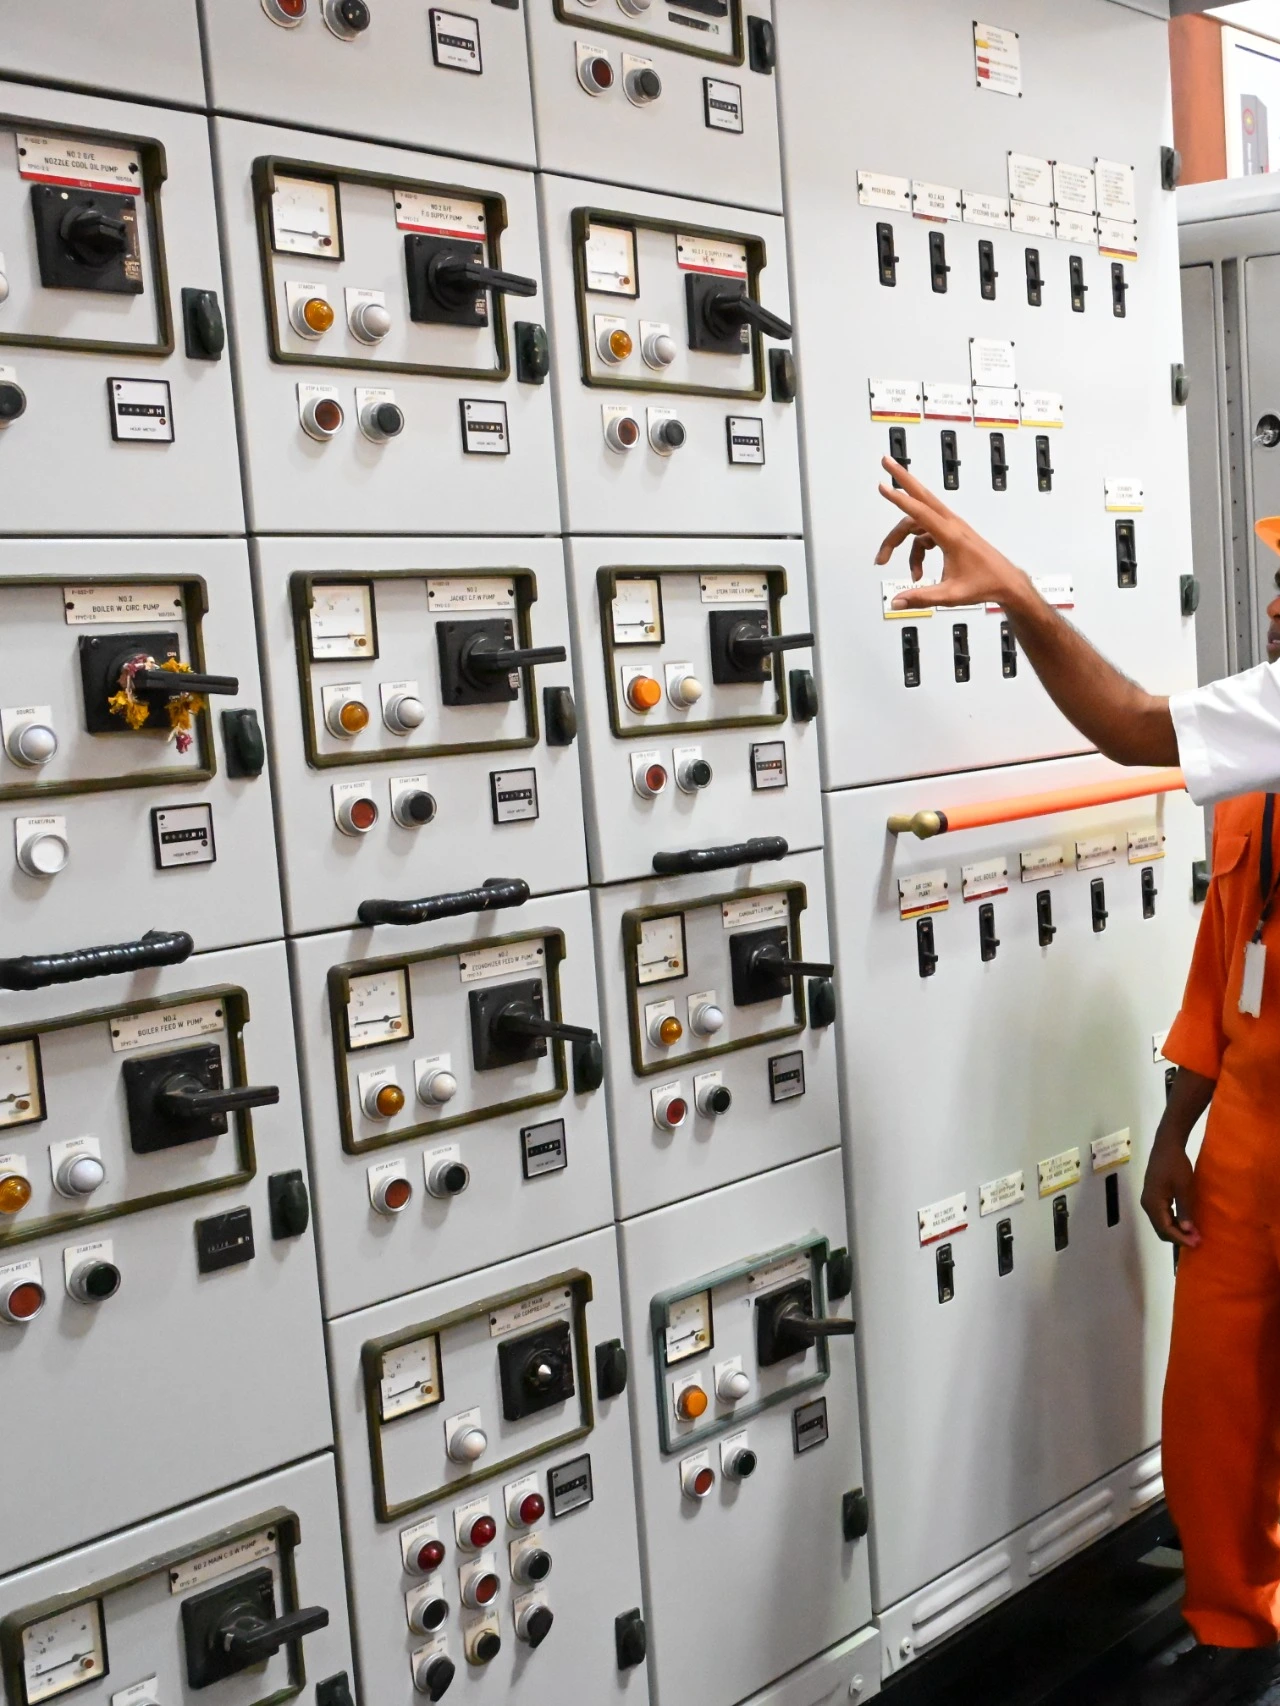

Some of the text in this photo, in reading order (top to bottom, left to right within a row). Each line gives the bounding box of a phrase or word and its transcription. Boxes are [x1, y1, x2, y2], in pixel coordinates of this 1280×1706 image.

[44, 157, 69, 168] NOZZLE
[71, 160, 88, 170] COOL
[100, 164, 119, 174] PUMP
[92, 604, 115, 614] BOILER
[142, 602, 160, 611] PUMP
[137, 1026, 159, 1038] BOILER
[160, 1022, 177, 1033] FEED
[186, 1017, 204, 1028] PUMP
[208, 1555, 223, 1567] MAIN
